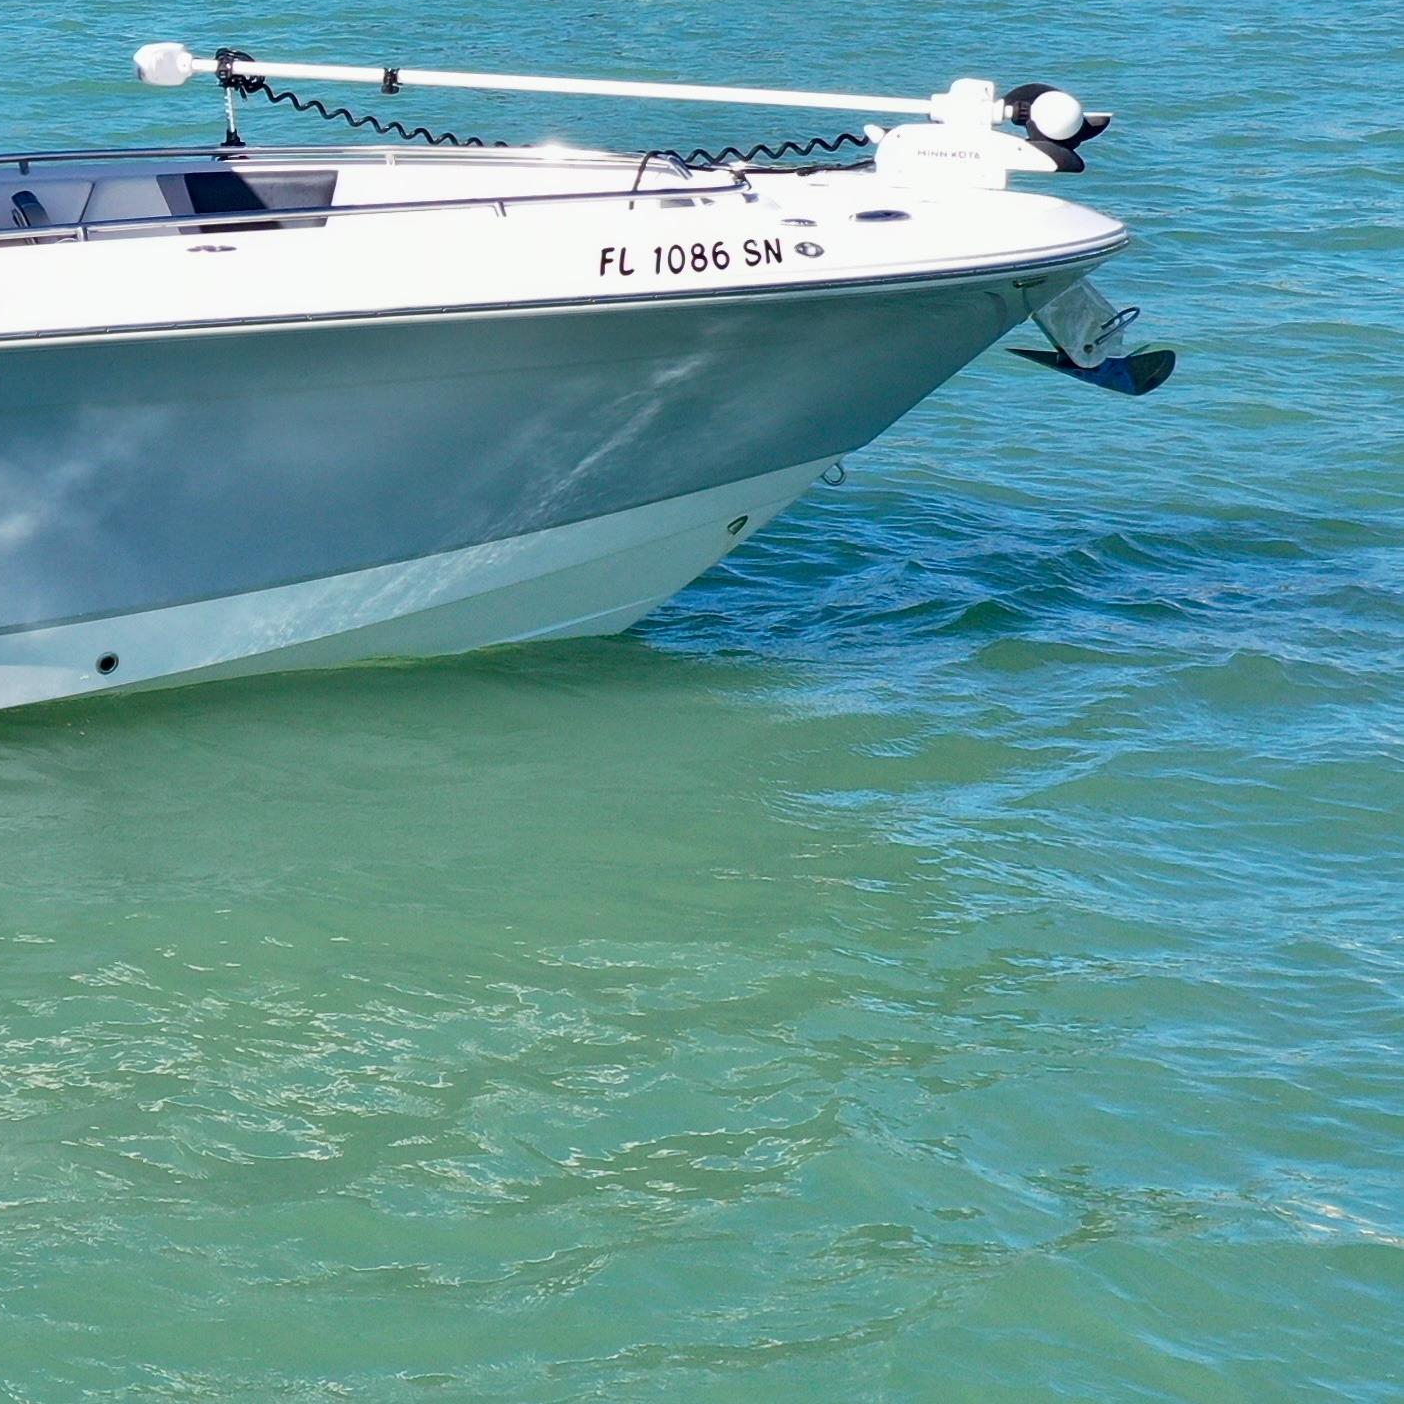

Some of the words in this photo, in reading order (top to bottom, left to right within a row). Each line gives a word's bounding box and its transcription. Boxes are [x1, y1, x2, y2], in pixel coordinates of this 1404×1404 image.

[599, 247, 636, 276] FL
[653, 241, 730, 274] 1086
[742, 238, 784, 267] SN
